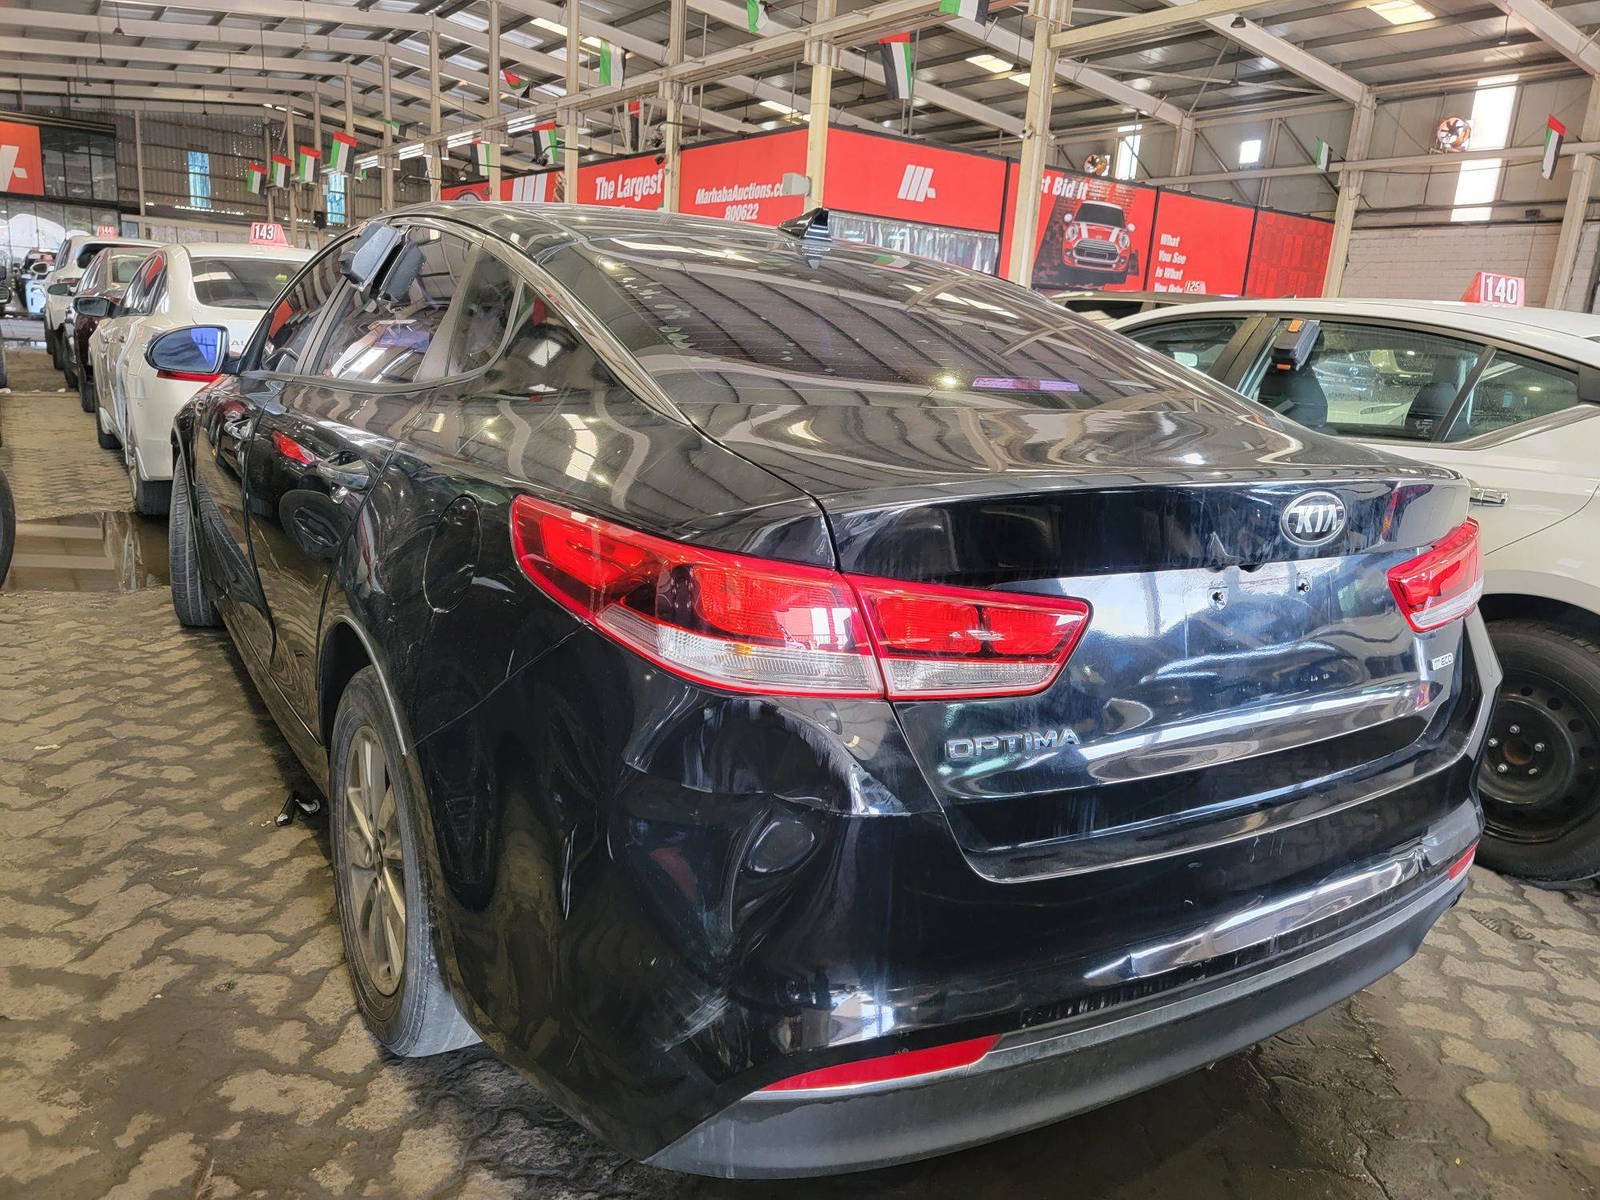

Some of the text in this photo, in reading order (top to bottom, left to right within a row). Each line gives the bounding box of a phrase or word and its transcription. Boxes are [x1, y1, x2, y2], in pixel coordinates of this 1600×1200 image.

[596, 168, 663, 202] The Largest
[1052, 176, 1076, 198] Bid
[1077, 181, 1089, 200] It
[725, 203, 759, 221] 800622
[254, 224, 274, 240] 143
[1160, 233, 1180, 247] What
[1158, 250, 1187, 264] You See
[1155, 266, 1184, 280] Is What
[1486, 276, 1518, 304] 140
[1295, 504, 1337, 534] KIA
[945, 728, 1081, 759] OPTIMA
